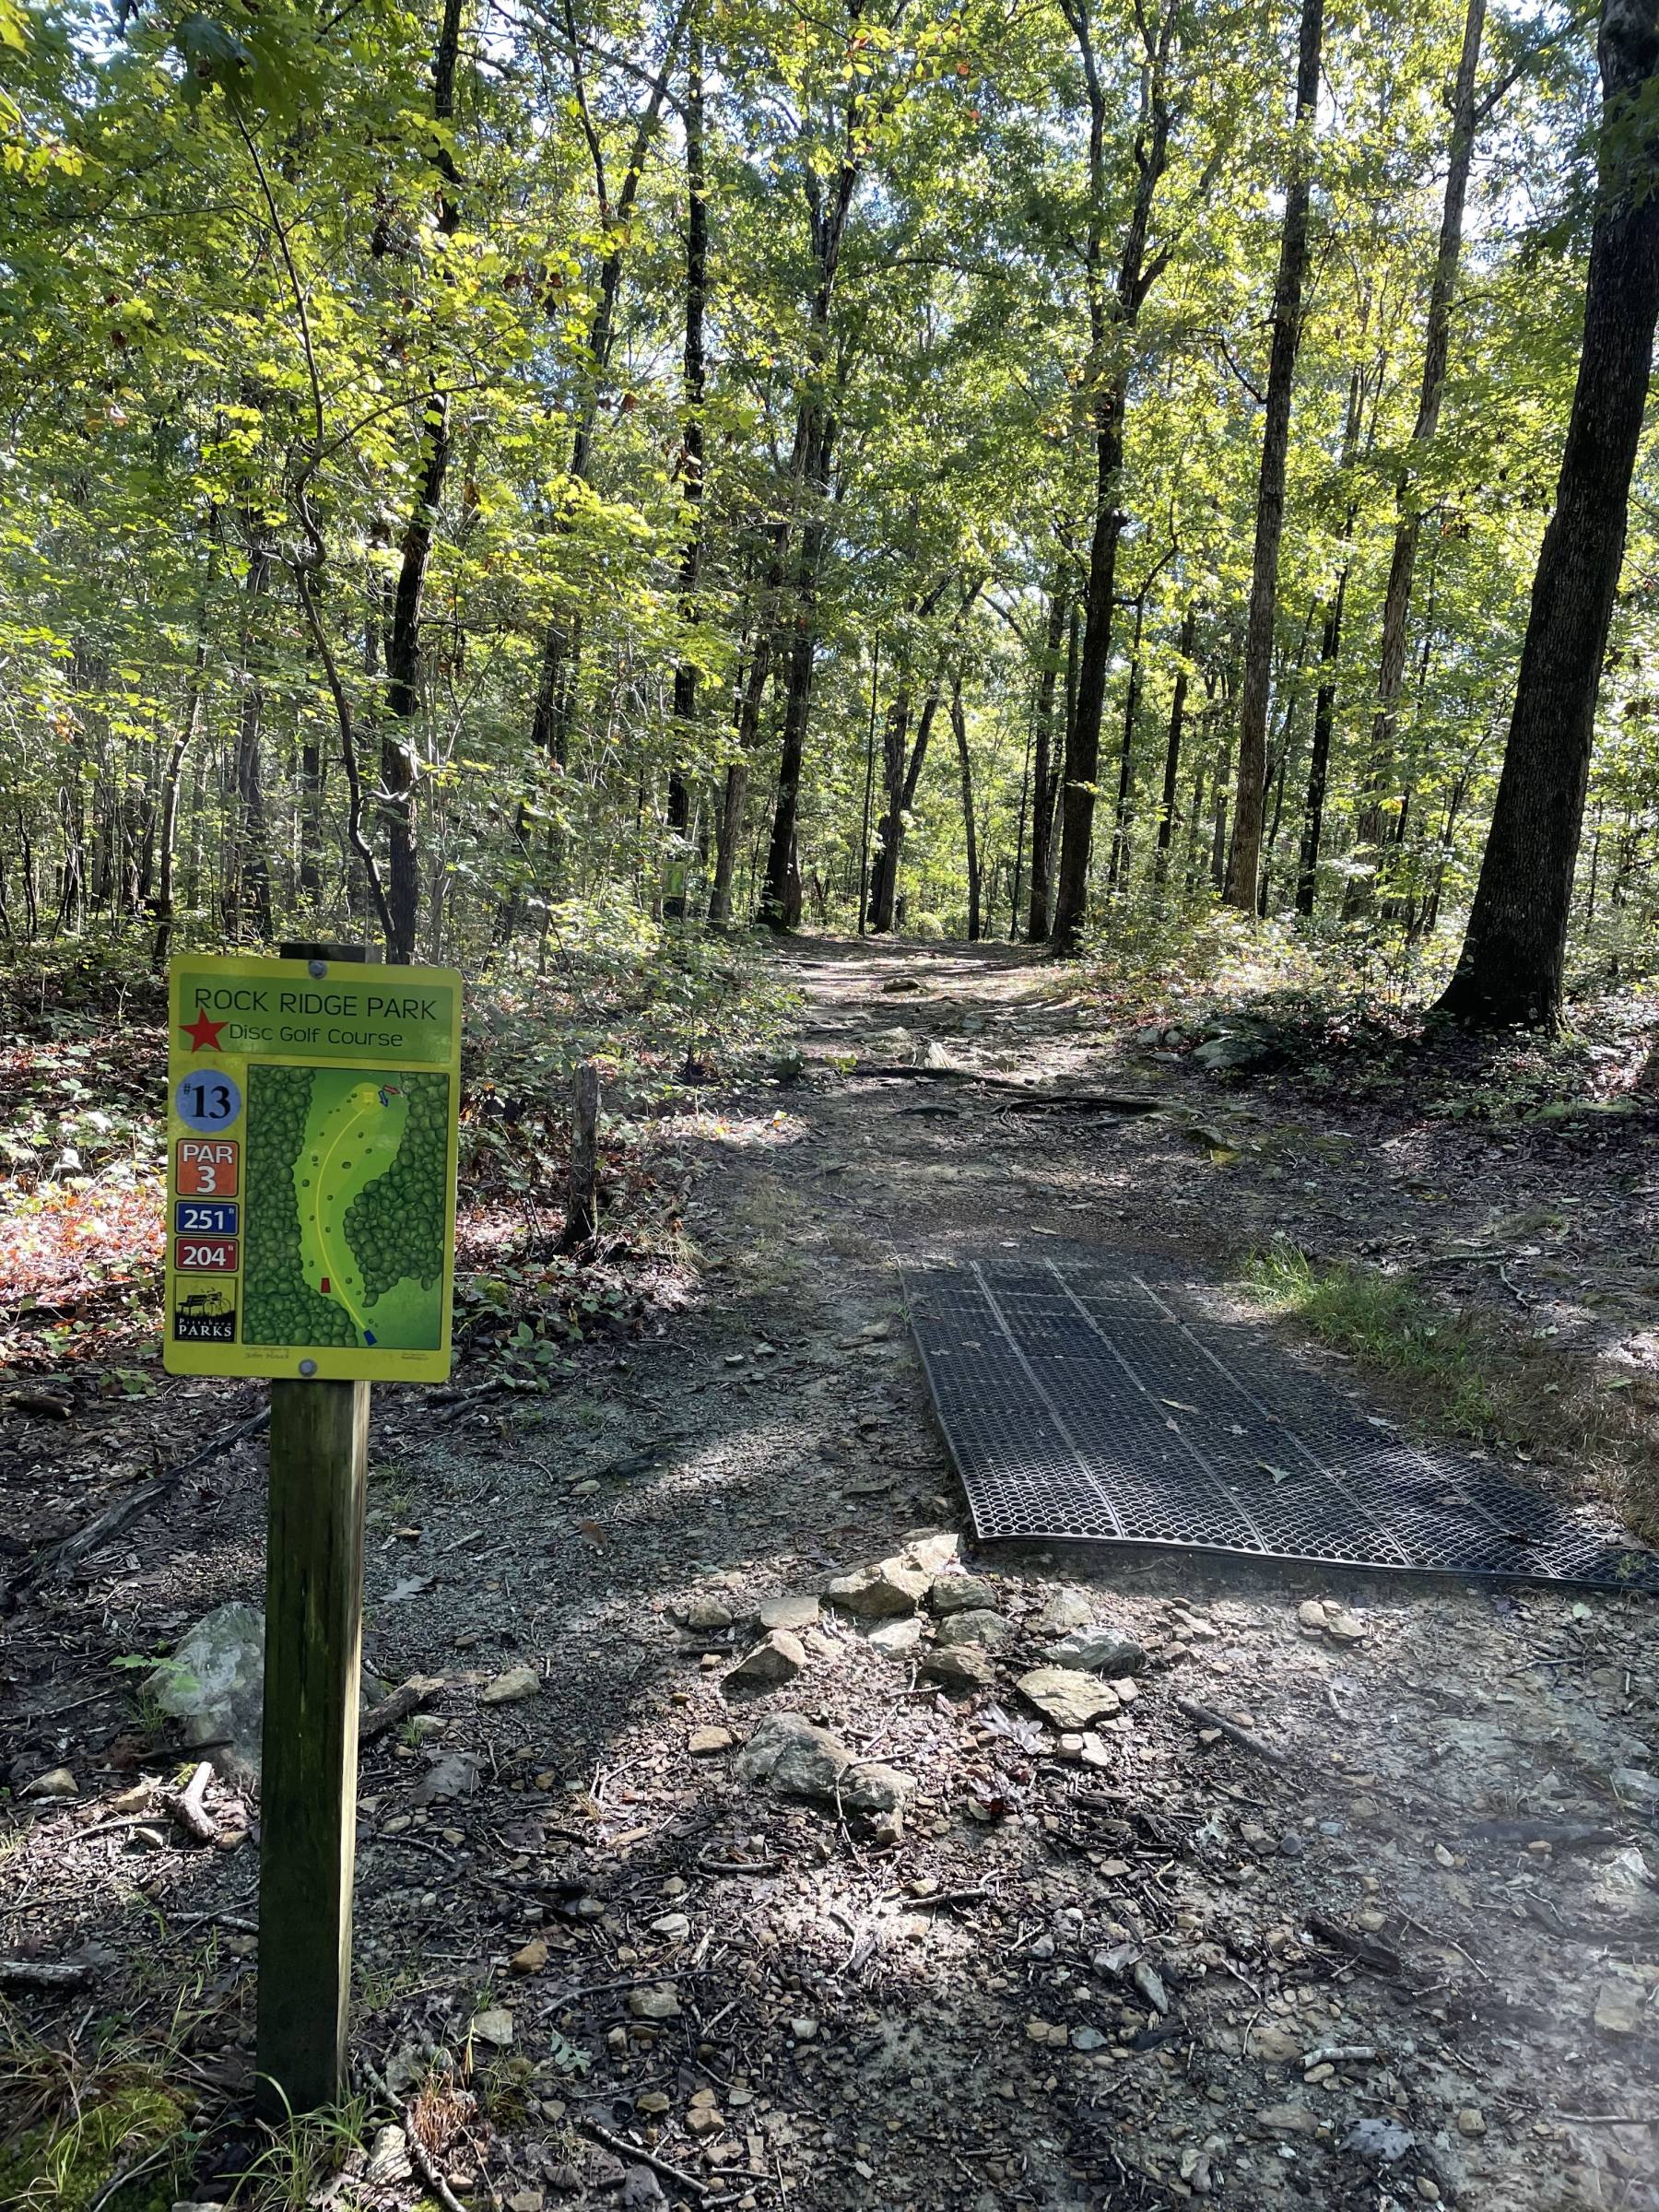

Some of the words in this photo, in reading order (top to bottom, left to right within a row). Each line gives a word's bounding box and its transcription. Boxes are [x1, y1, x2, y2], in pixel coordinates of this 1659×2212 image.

[194, 988, 269, 1012] ROCK
[279, 993, 358, 1017] RIDGE
[368, 997, 437, 1020] PARK
[229, 1024, 273, 1041] Disc
[279, 1026, 321, 1043] Golf
[327, 1029, 403, 1047] Course
[183, 1083, 230, 1119] #13
[182, 1144, 233, 1164] PAR
[196, 1165, 217, 1194] 3
[184, 1209, 224, 1230] 251
[182, 1245, 227, 1266] 204
[178, 1324, 232, 1336] PARKS
